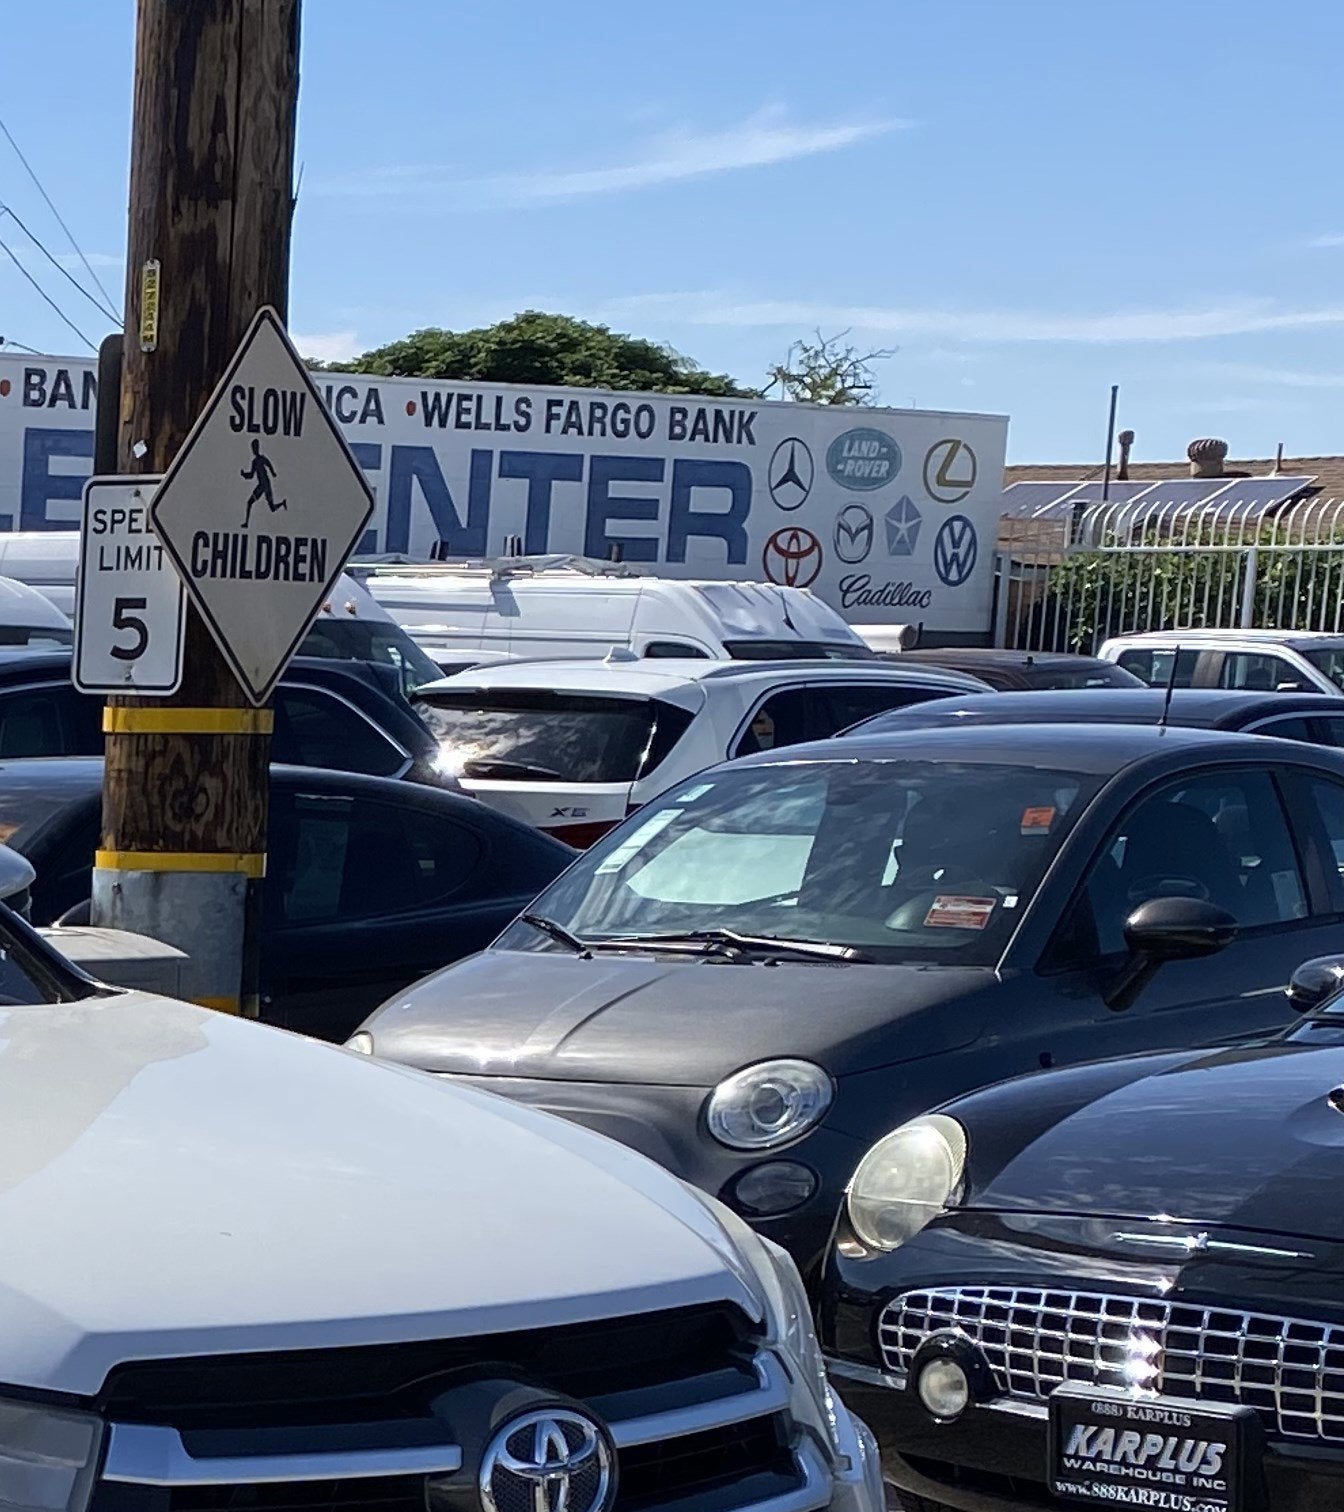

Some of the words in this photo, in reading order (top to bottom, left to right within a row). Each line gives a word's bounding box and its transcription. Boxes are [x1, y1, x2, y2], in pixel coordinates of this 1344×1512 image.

[229, 385, 307, 438] SLOW
[316, 385, 386, 426] ICA
[420, 390, 533, 433] WELLS
[544, 398, 656, 440] FARGO
[668, 406, 759, 446] BANK
[191, 530, 328, 584] CHILDREN
[838, 573, 932, 609] Cadillac
[109, 597, 149, 661] 5
[1126, 1405, 1192, 1428] KARPLUS
[1062, 1456, 1187, 1486] WAREHOUSE
[1064, 1423, 1227, 1476] KARPLUS
